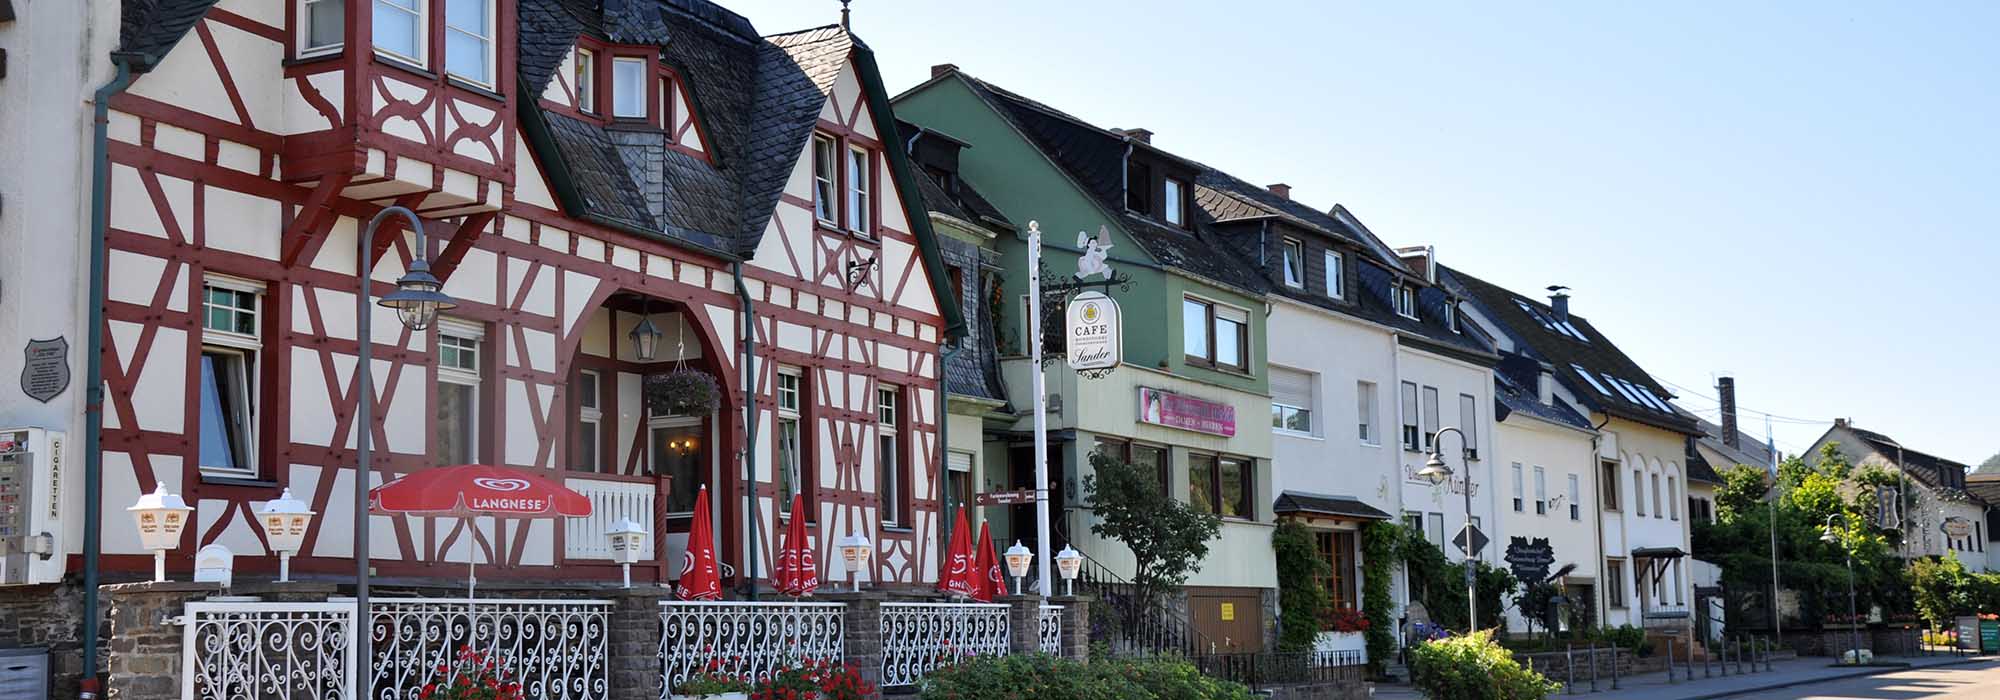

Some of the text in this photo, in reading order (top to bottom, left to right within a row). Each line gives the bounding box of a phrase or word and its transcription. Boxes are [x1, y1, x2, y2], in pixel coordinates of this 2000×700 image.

[1075, 325, 1108, 336] CAFE
[1072, 347, 1111, 364] Sander
[51, 441, 60, 517] CIGARETTEN
[473, 497, 543, 510] LANGNESE
